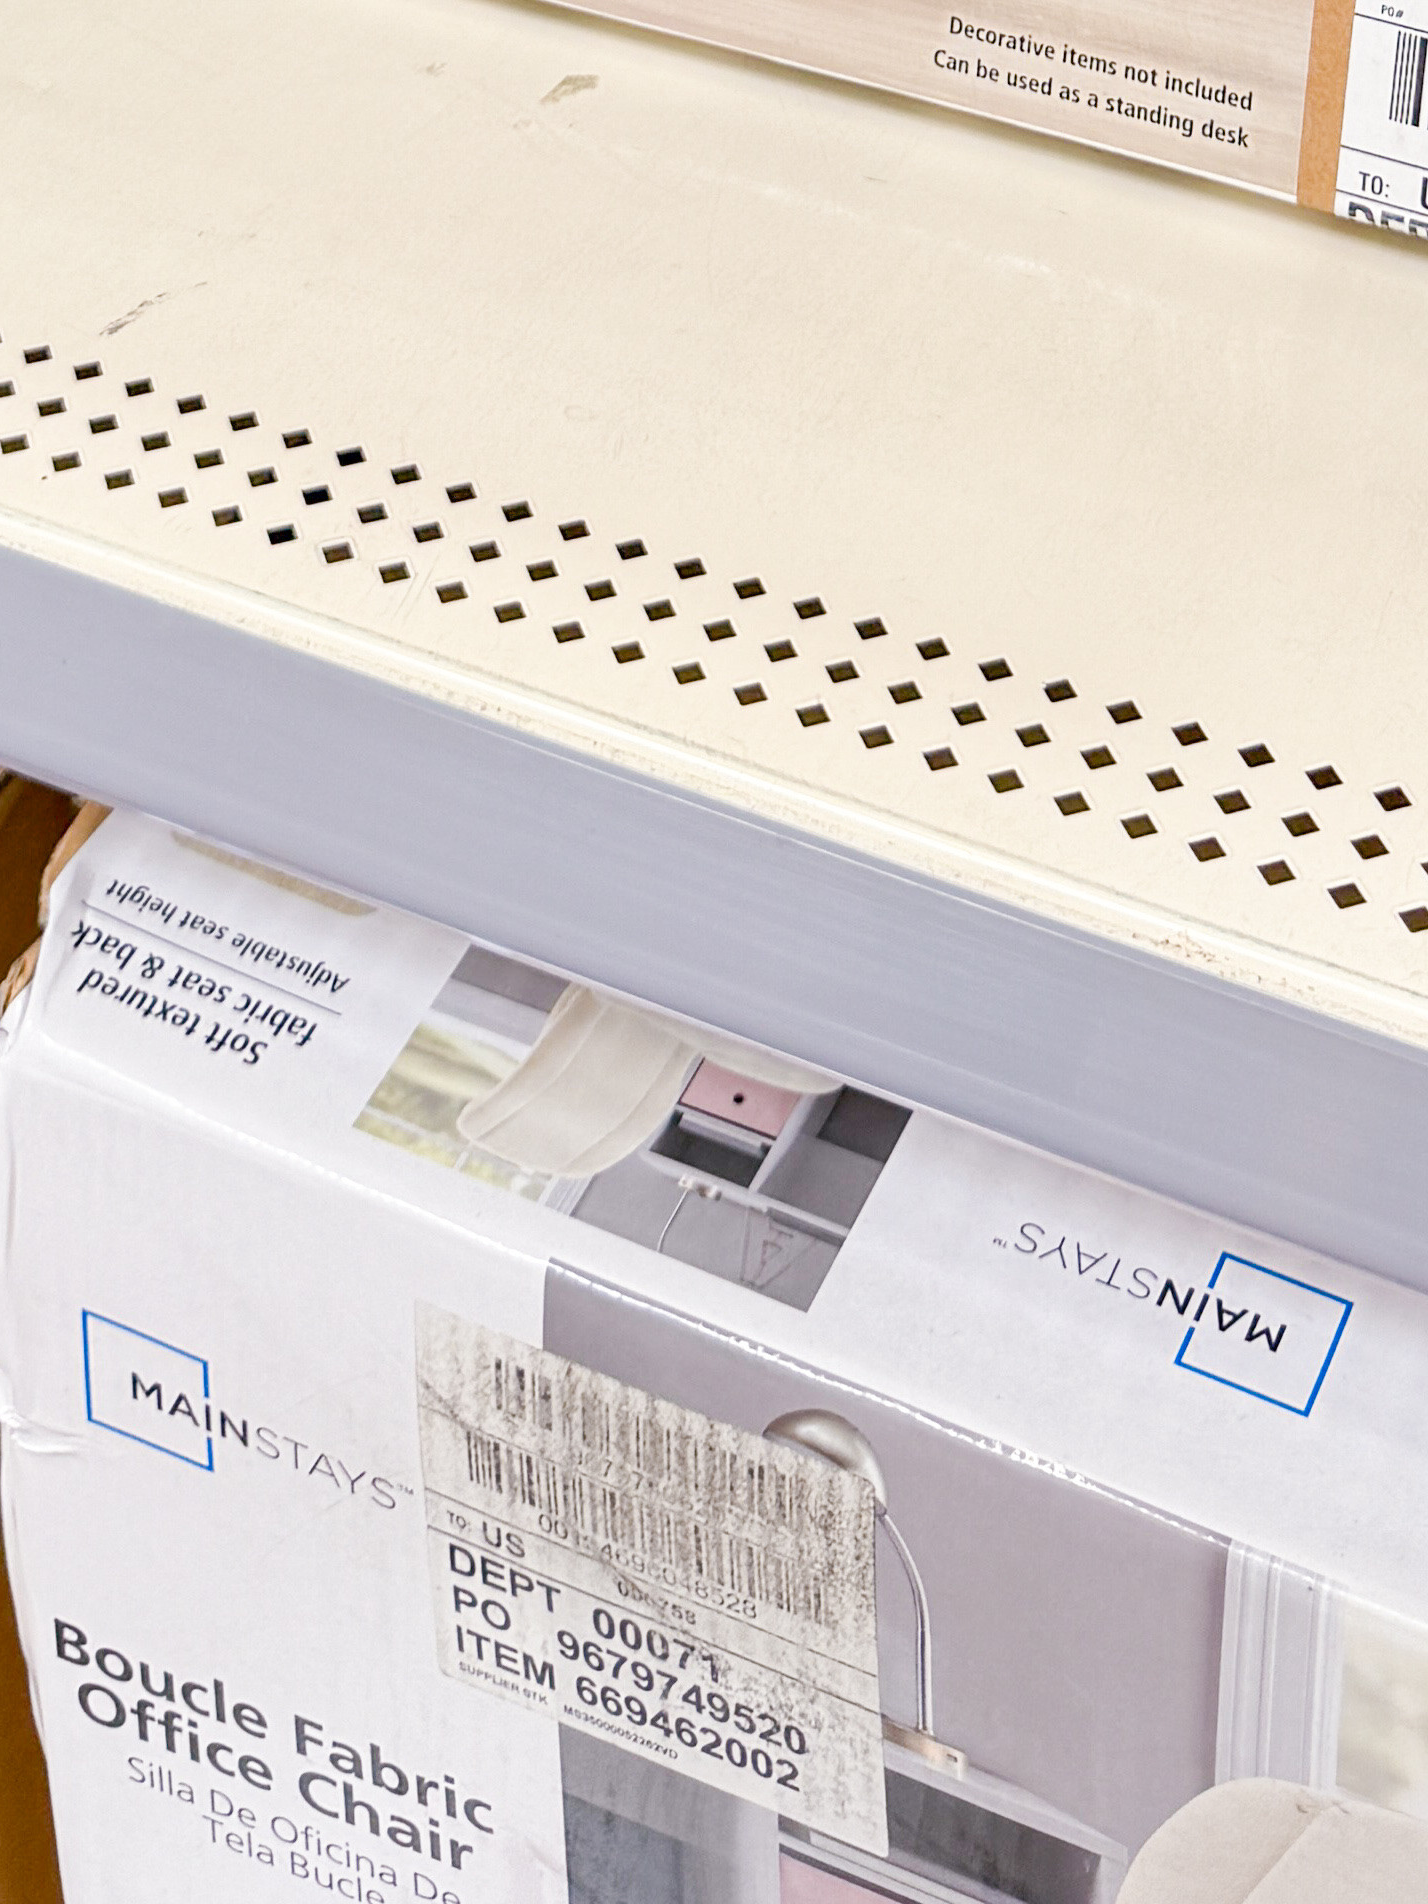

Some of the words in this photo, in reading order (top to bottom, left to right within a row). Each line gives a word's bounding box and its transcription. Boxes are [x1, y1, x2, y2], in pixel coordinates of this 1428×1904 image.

[949, 15, 1055, 60] Decorative
[1062, 43, 1117, 76] items
[1124, 65, 1158, 87] not
[1164, 70, 1253, 111] included
[934, 49, 969, 75] Can
[976, 58, 1000, 83] be
[1007, 71, 1053, 97] used
[1058, 85, 1080, 104] as
[1087, 93, 1099, 109] a
[1105, 97, 1194, 138] standing
[1201, 119, 1249, 148] desk
[1358, 171, 1390, 198] TO:
[105, 879, 178, 924] height
[178, 910, 229, 940] seat
[71, 920, 138, 971] back
[140, 953, 165, 980] &
[231, 933, 351, 994] Adjustable
[76, 968, 201, 1036] textured
[167, 965, 233, 1004] seat
[204, 1022, 268, 1065] Soft
[232, 993, 317, 1047] fabric
[482, 1520, 526, 1559] US
[448, 1542, 561, 1613] DEPT
[592, 1608, 725, 1684] 00071
[452, 1584, 512, 1631] PO
[556, 1629, 810, 1756] 9679749520
[53, 1617, 268, 1739] Boucle
[294, 1714, 494, 1835] Fabric
[456, 1624, 556, 1691] ITEM
[575, 1675, 800, 1793] 669462002
[77, 1682, 273, 1791] Office
[298, 1771, 473, 1871] Chair
[127, 1756, 195, 1805] Silla
[210, 1788, 257, 1829] De
[270, 1816, 398, 1888] Oficina
[201, 1814, 275, 1867] Tela
[290, 1851, 392, 1904] Bucle
